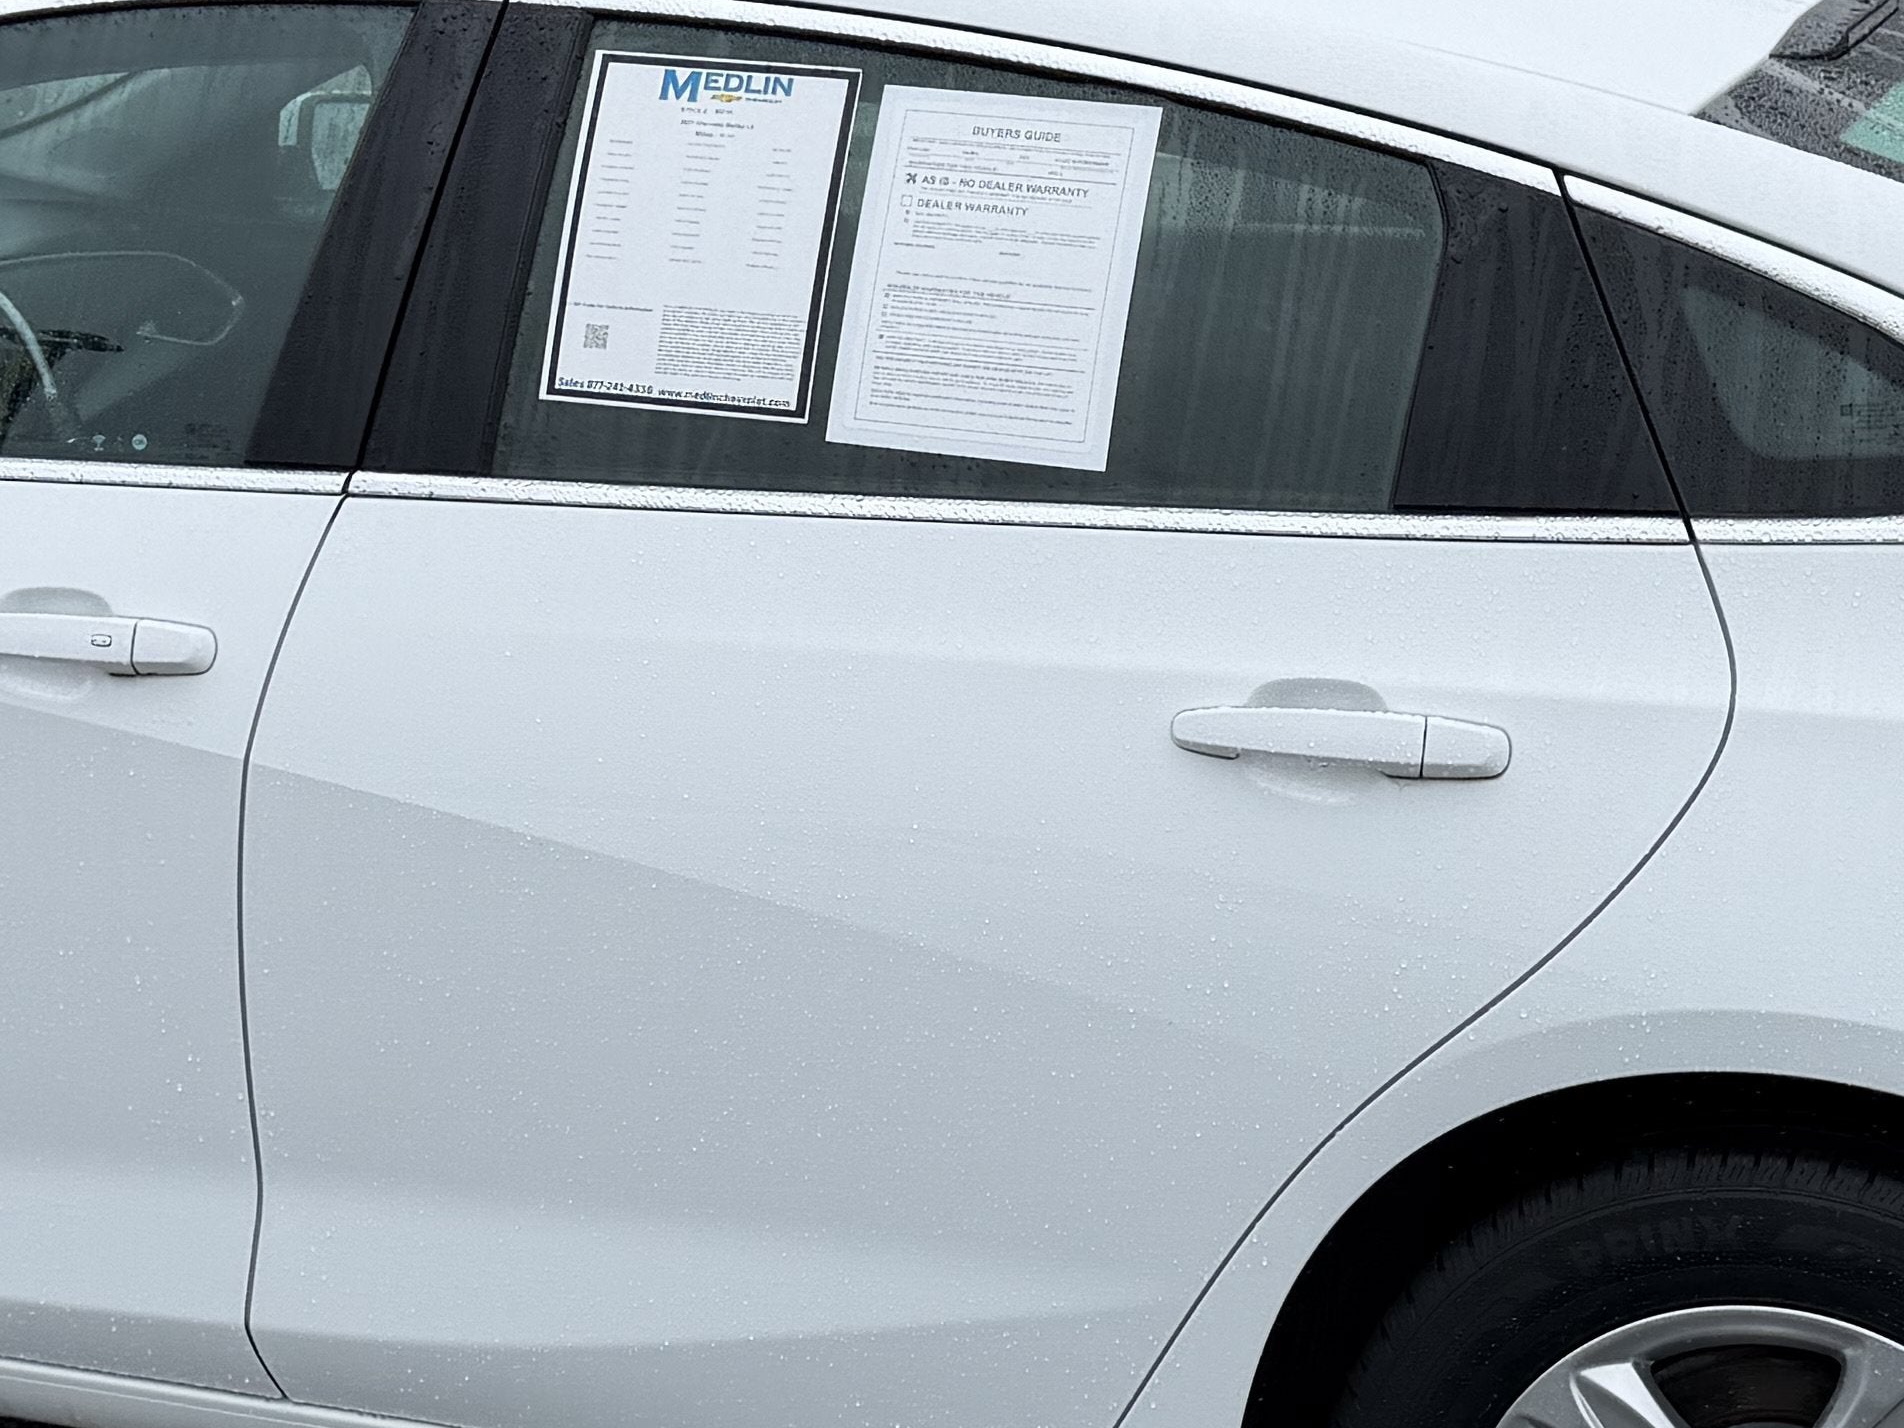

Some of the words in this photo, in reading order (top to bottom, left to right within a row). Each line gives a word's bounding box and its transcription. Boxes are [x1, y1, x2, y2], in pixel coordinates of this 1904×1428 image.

[659, 68, 794, 103] MEDLIN
[972, 126, 1021, 140] BUYERS
[1024, 129, 1062, 143] GUIDE
[921, 174, 936, 185] AS
[959, 178, 976, 188] NO
[978, 179, 1024, 193] DEALER
[1026, 183, 1090, 198] WARRANTY
[917, 198, 962, 211] DEALER
[965, 202, 1030, 217] WARRANTY
